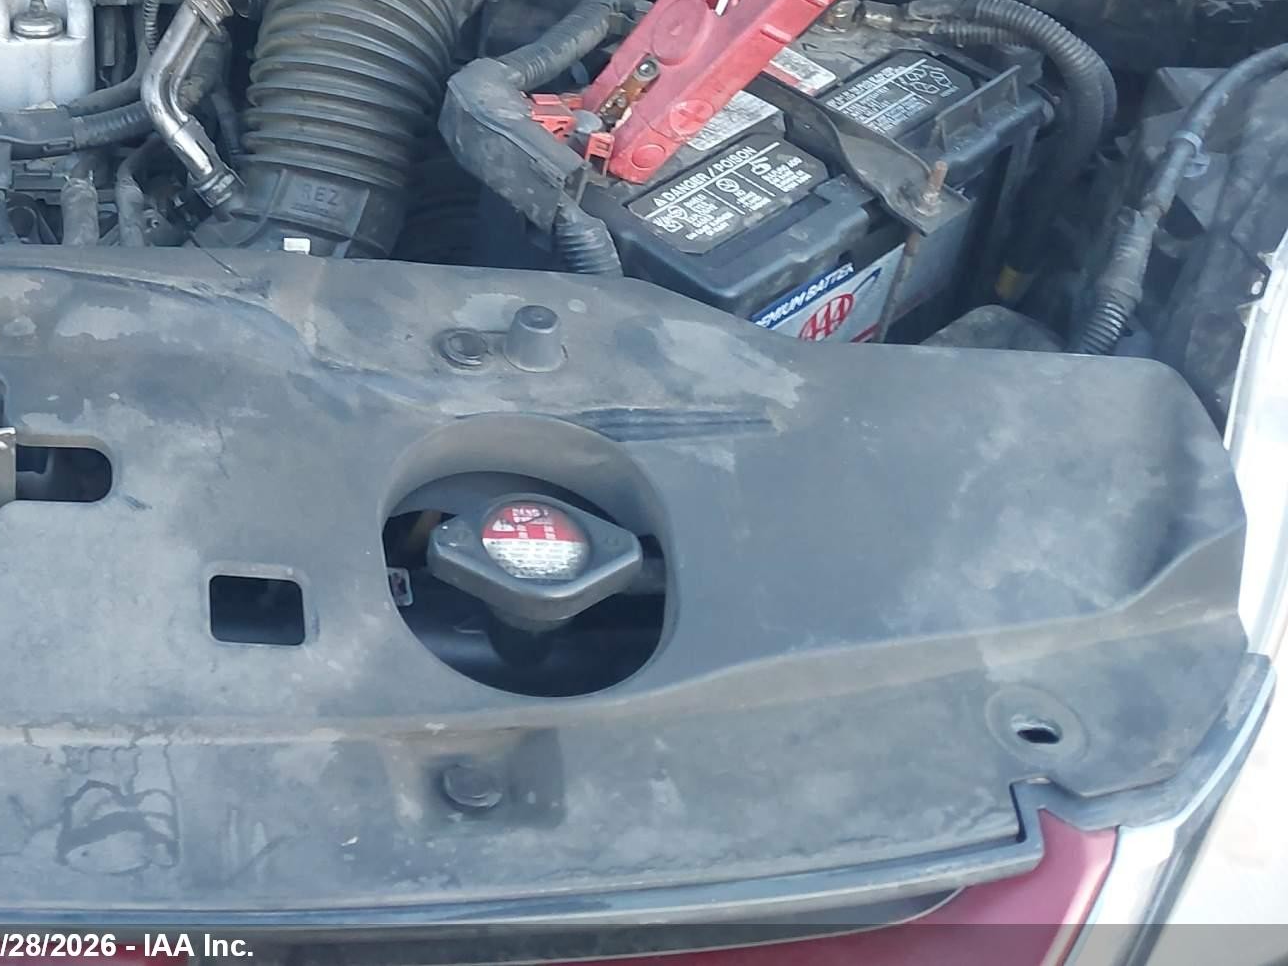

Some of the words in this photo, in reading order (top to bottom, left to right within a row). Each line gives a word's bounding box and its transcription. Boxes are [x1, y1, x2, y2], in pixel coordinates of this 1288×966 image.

[661, 171, 711, 202] DANGER
[714, 145, 760, 173] POISON
[805, 262, 855, 302] BATTER
